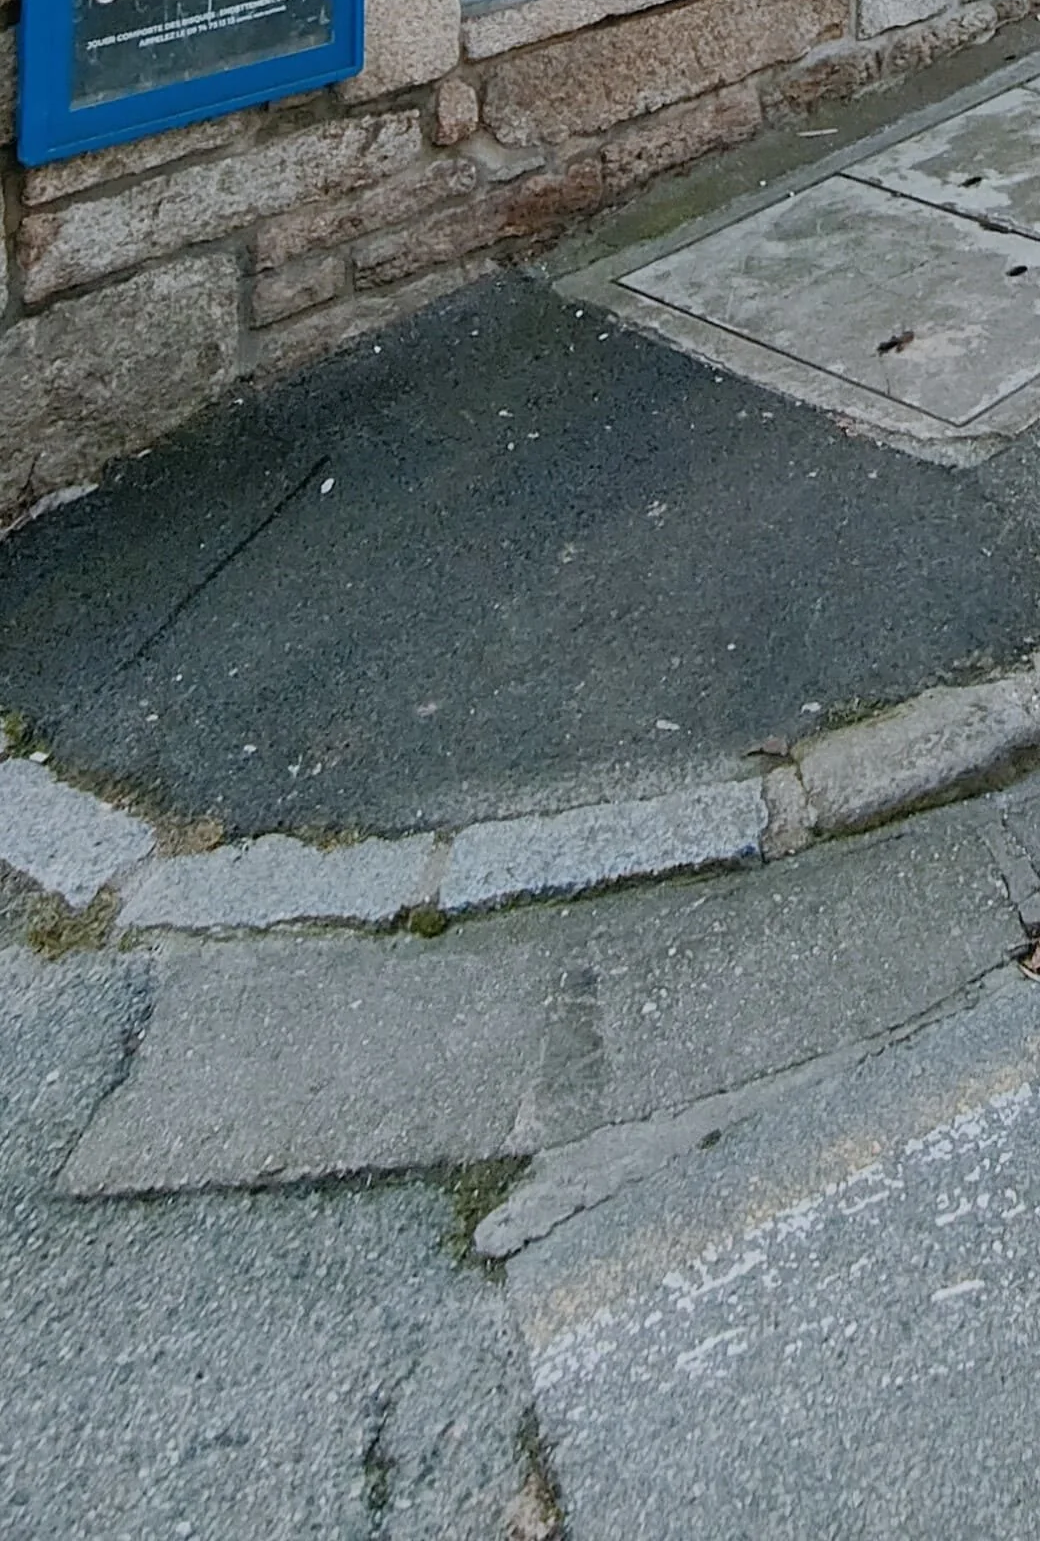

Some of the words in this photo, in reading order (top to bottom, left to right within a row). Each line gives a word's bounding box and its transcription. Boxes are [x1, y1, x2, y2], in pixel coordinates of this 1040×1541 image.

[86, 35, 116, 50] JOUER
[116, 24, 163, 42] COMPORTE
[139, 32, 175, 48] APPELEZ
[176, 29, 186, 38] LE
